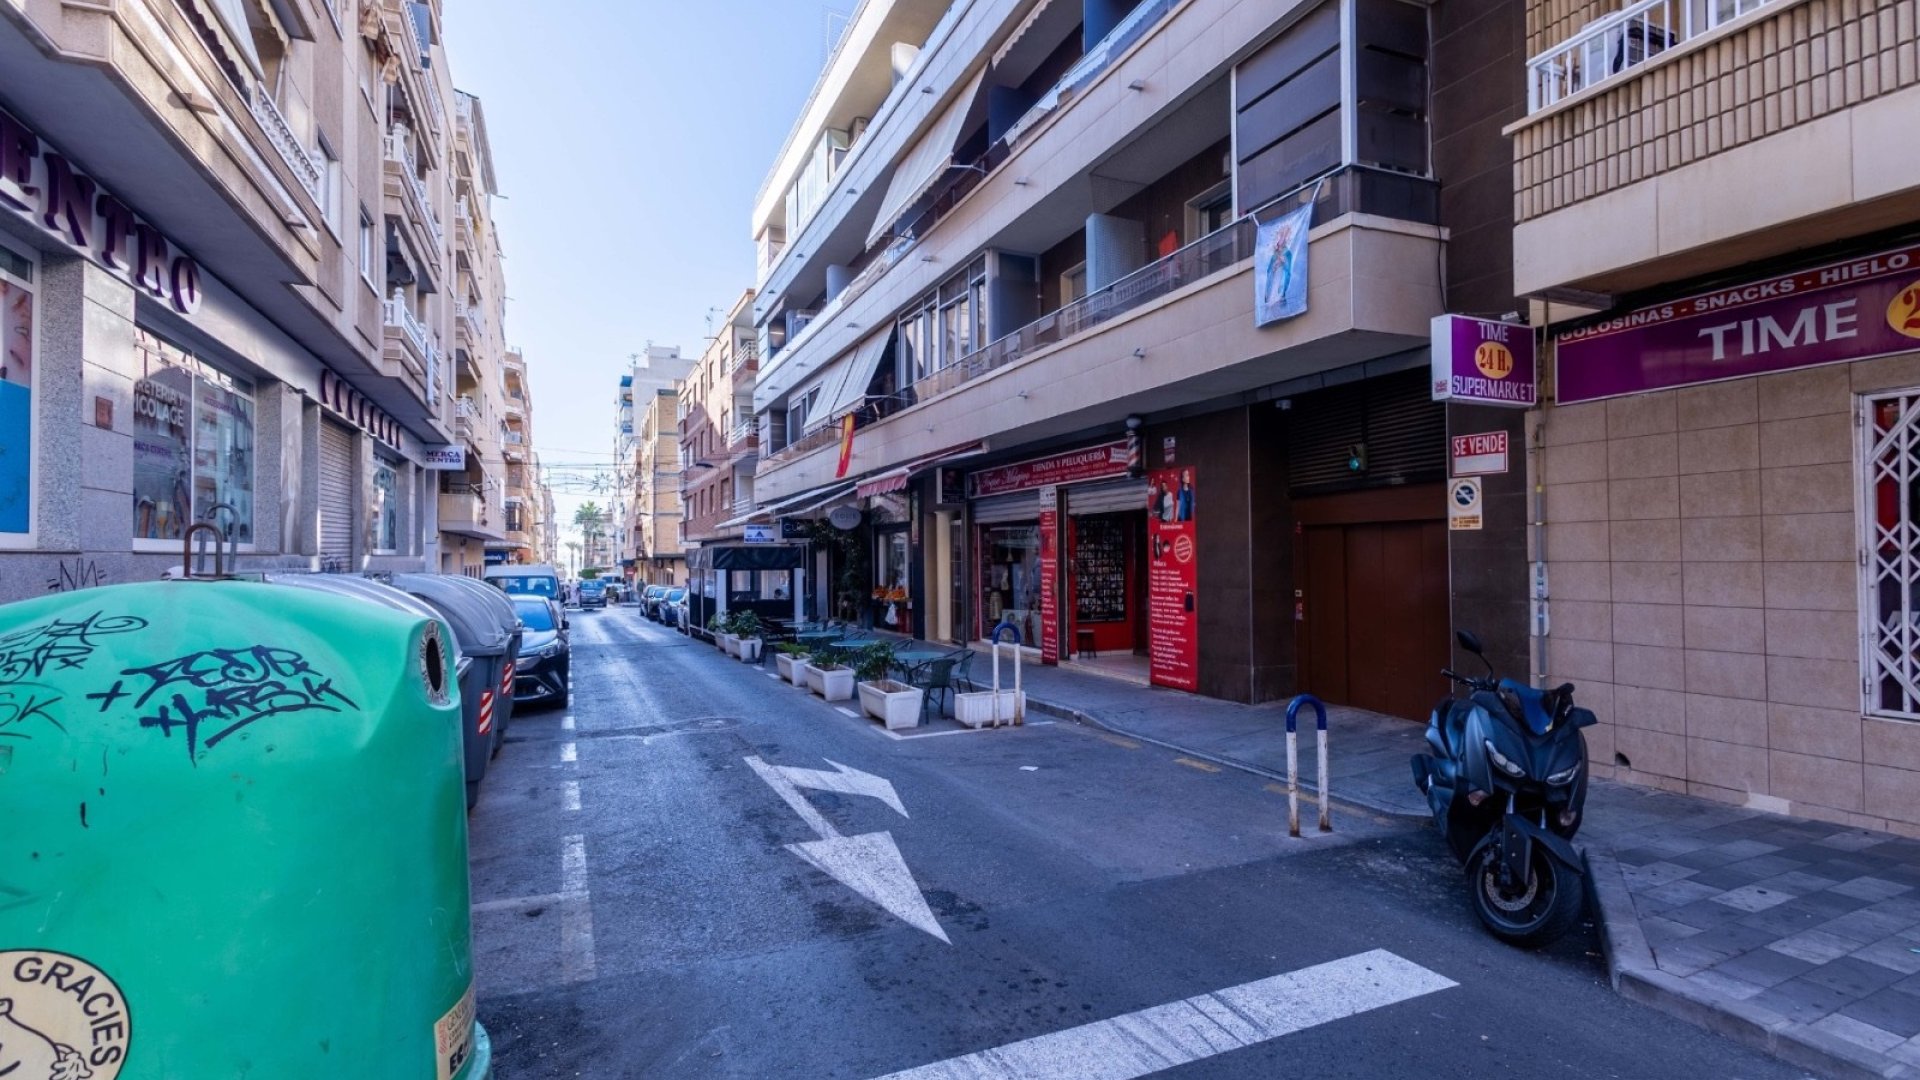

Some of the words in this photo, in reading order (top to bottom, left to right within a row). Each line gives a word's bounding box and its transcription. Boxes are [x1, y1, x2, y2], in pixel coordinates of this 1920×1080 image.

[1694, 278, 1795, 313] SNACKS
[1820, 253, 1910, 285] HIELO
[1478, 321, 1509, 342] TIME
[1697, 297, 1858, 362] TIME
[1479, 346, 1494, 370] 24
[1452, 375, 1534, 401] SUPERMARKET
[1454, 439, 1467, 456] SE
[1468, 434, 1505, 455] VENDE
[1032, 459, 1055, 473] TIENDA
[14, 956, 124, 1066] GRACIES
